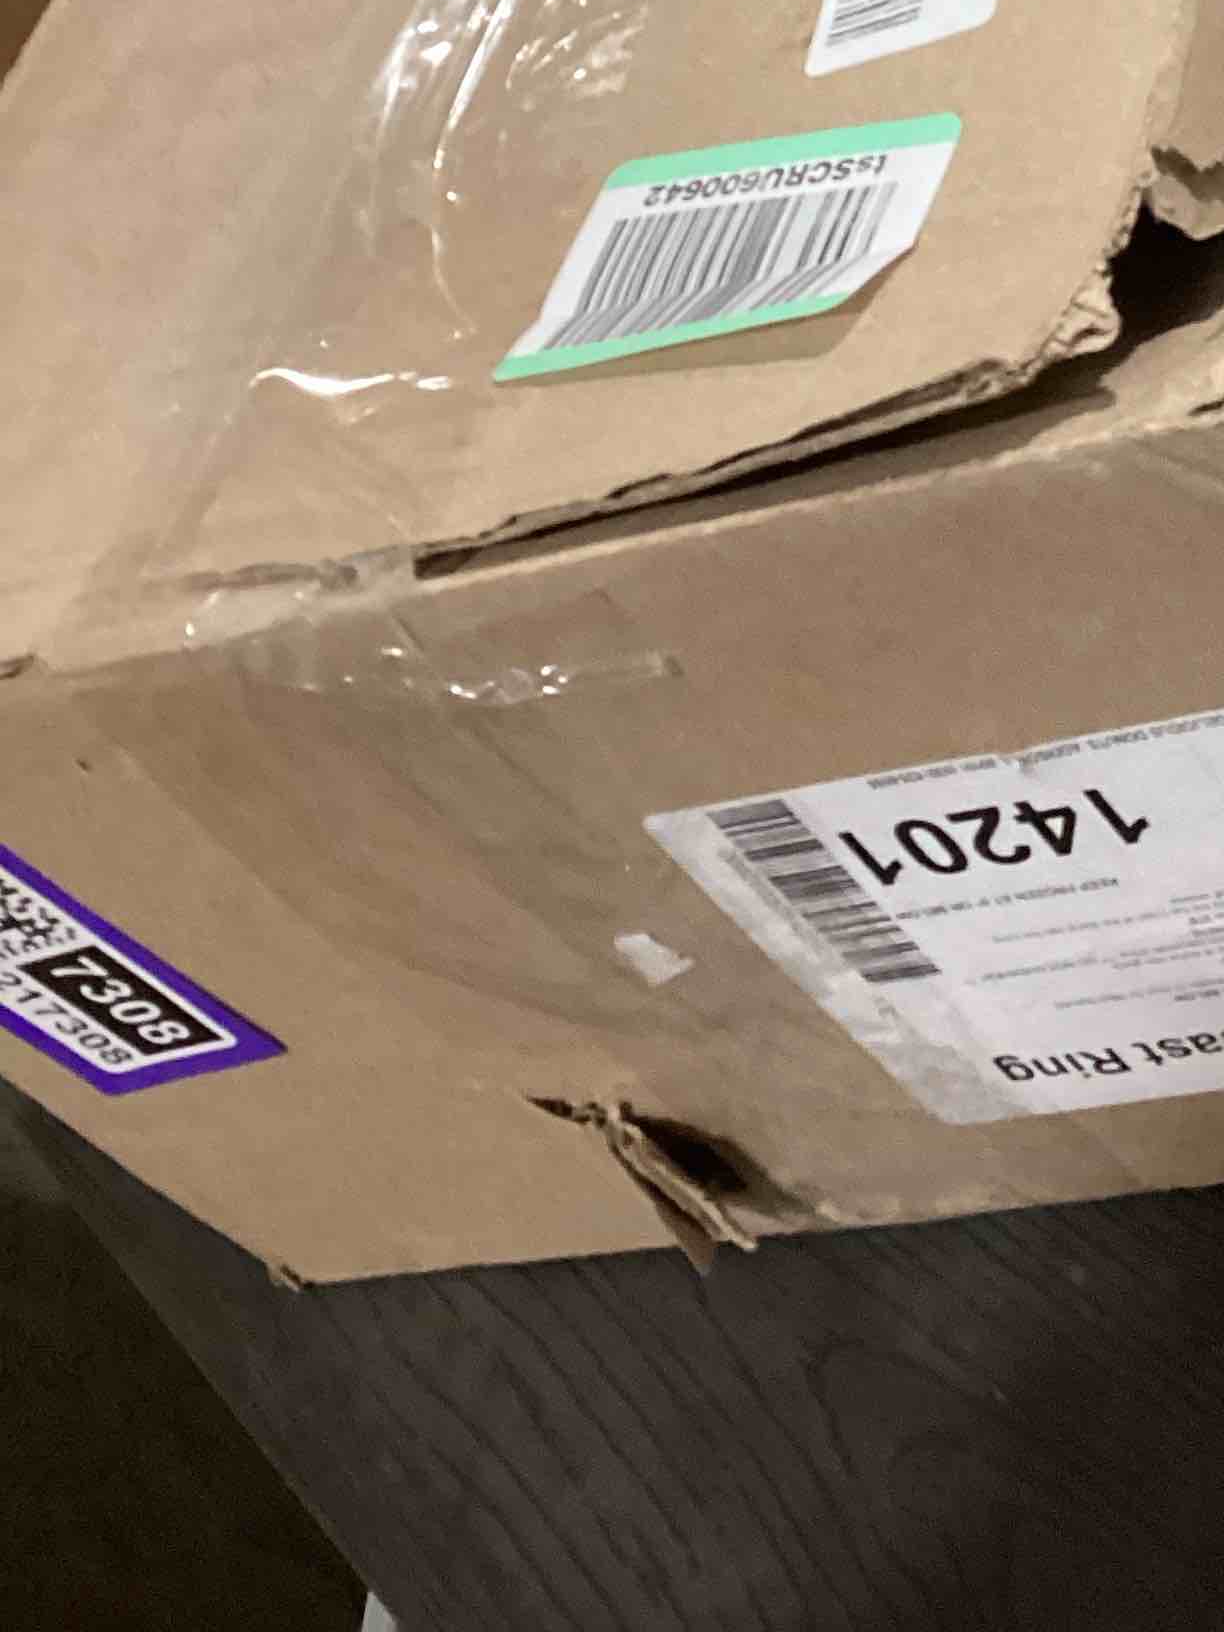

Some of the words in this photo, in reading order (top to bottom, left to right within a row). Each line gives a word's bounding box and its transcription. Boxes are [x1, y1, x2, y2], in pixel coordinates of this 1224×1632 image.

[643, 153, 887, 206] tsSCRU600642
[838, 787, 1151, 887] 14201
[50, 956, 190, 1045] 7308
[994, 1045, 1132, 1084] Ring
